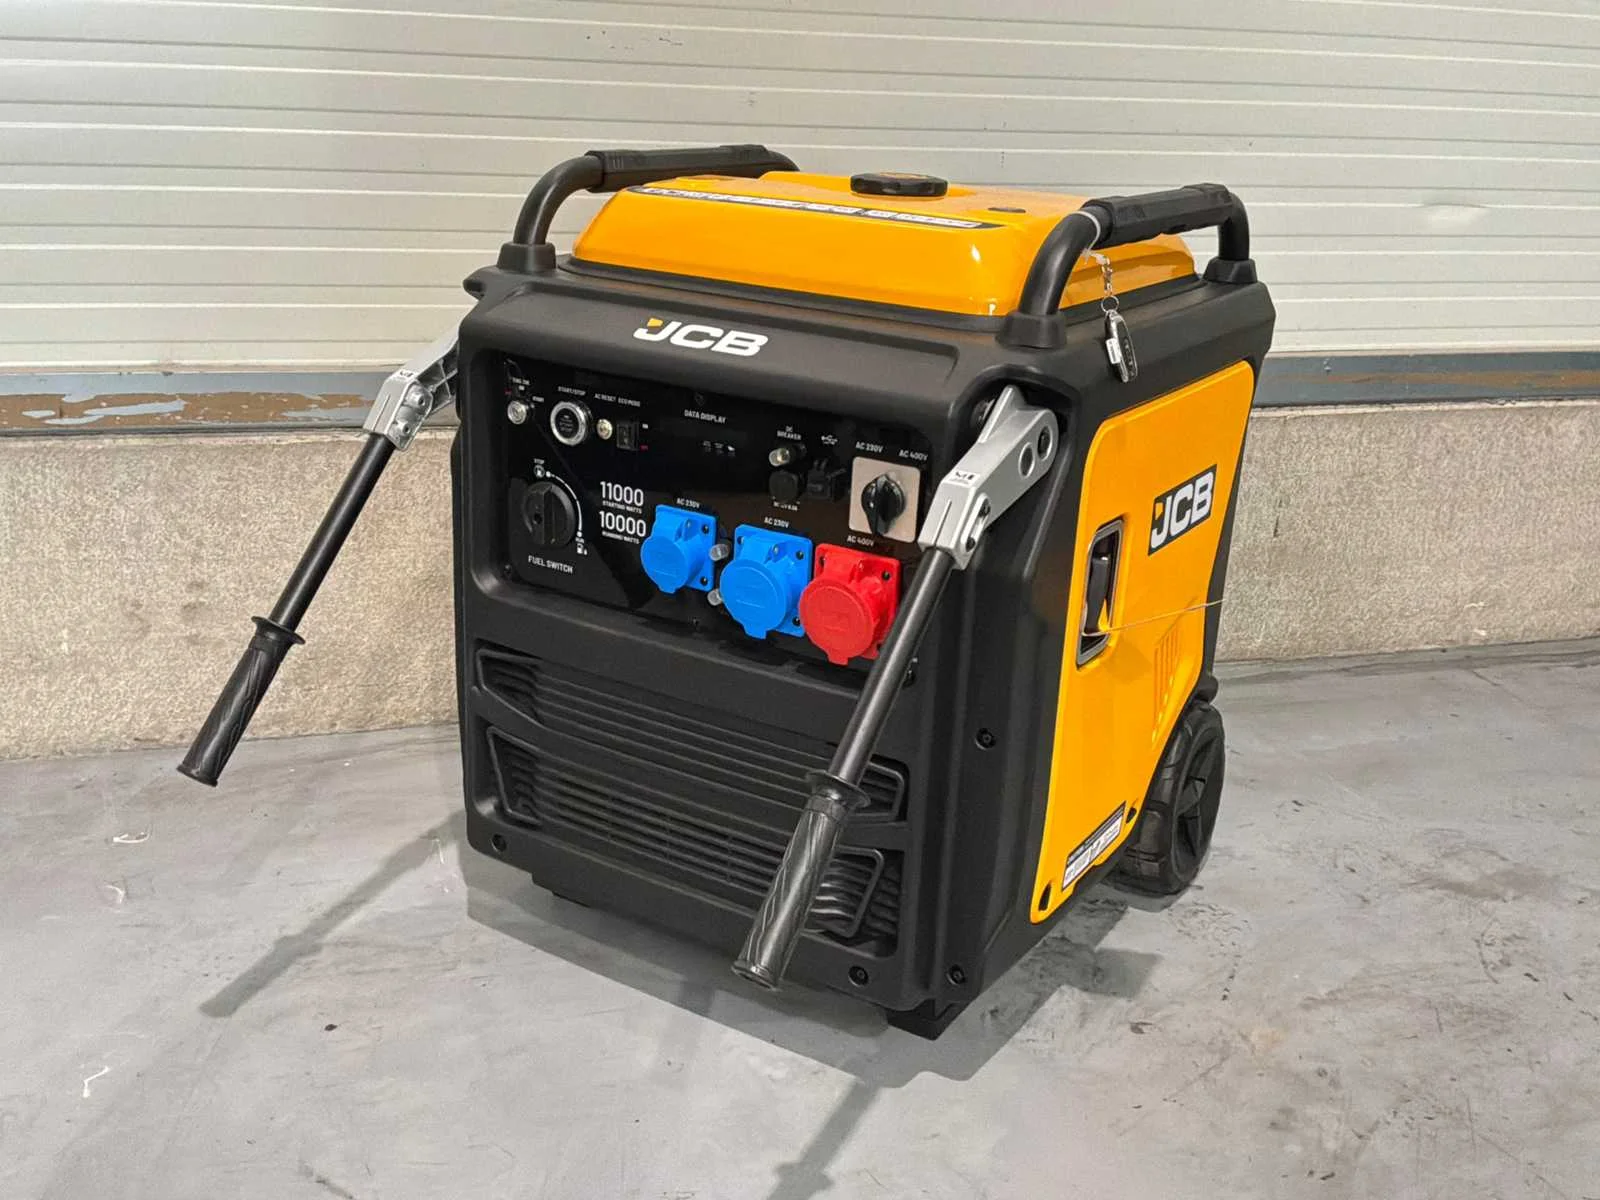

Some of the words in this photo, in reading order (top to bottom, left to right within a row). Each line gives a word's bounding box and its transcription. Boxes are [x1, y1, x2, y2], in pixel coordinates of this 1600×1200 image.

[633, 317, 769, 357] JCB
[684, 409, 700, 420] DATA
[700, 412, 727, 424] DISPLAY
[776, 430, 802, 441] BREAKER
[855, 441, 866, 450] AC
[866, 443, 884, 453] 230V
[899, 449, 909, 458] AC
[909, 451, 929, 461] 400V
[600, 480, 644, 507] 11000
[685, 499, 700, 508] 230V
[1150, 471, 1214, 549] JCB
[599, 510, 647, 537] 10000
[764, 516, 773, 525] AC
[773, 518, 790, 528] 230V
[847, 535, 857, 543] AC
[857, 537, 875, 547] 400V
[528, 555, 546, 567] FUEL
[546, 559, 574, 574] SWITCH
